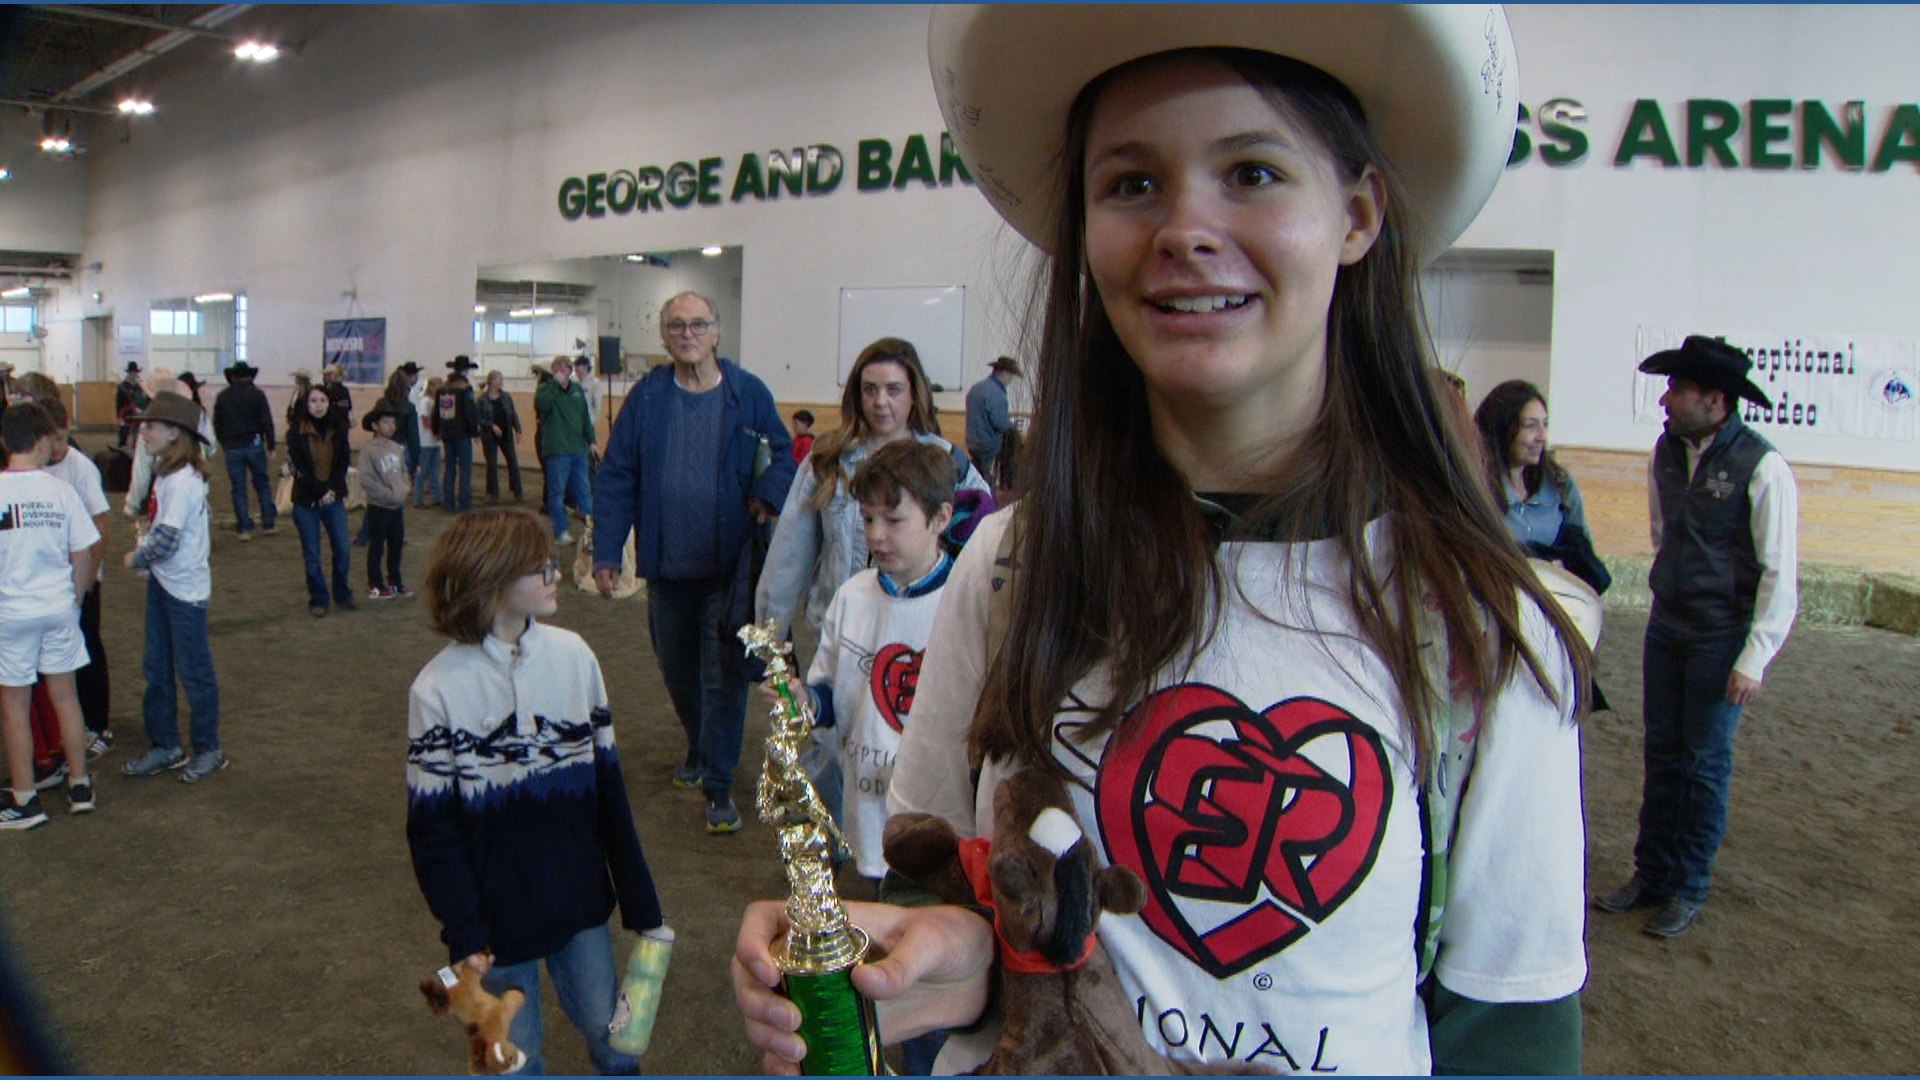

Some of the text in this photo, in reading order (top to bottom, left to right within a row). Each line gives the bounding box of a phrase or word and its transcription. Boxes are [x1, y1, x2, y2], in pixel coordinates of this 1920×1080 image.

[557, 156, 724, 221] GEORGE
[730, 144, 844, 203] AND
[1612, 97, 1920, 174] ARENA
